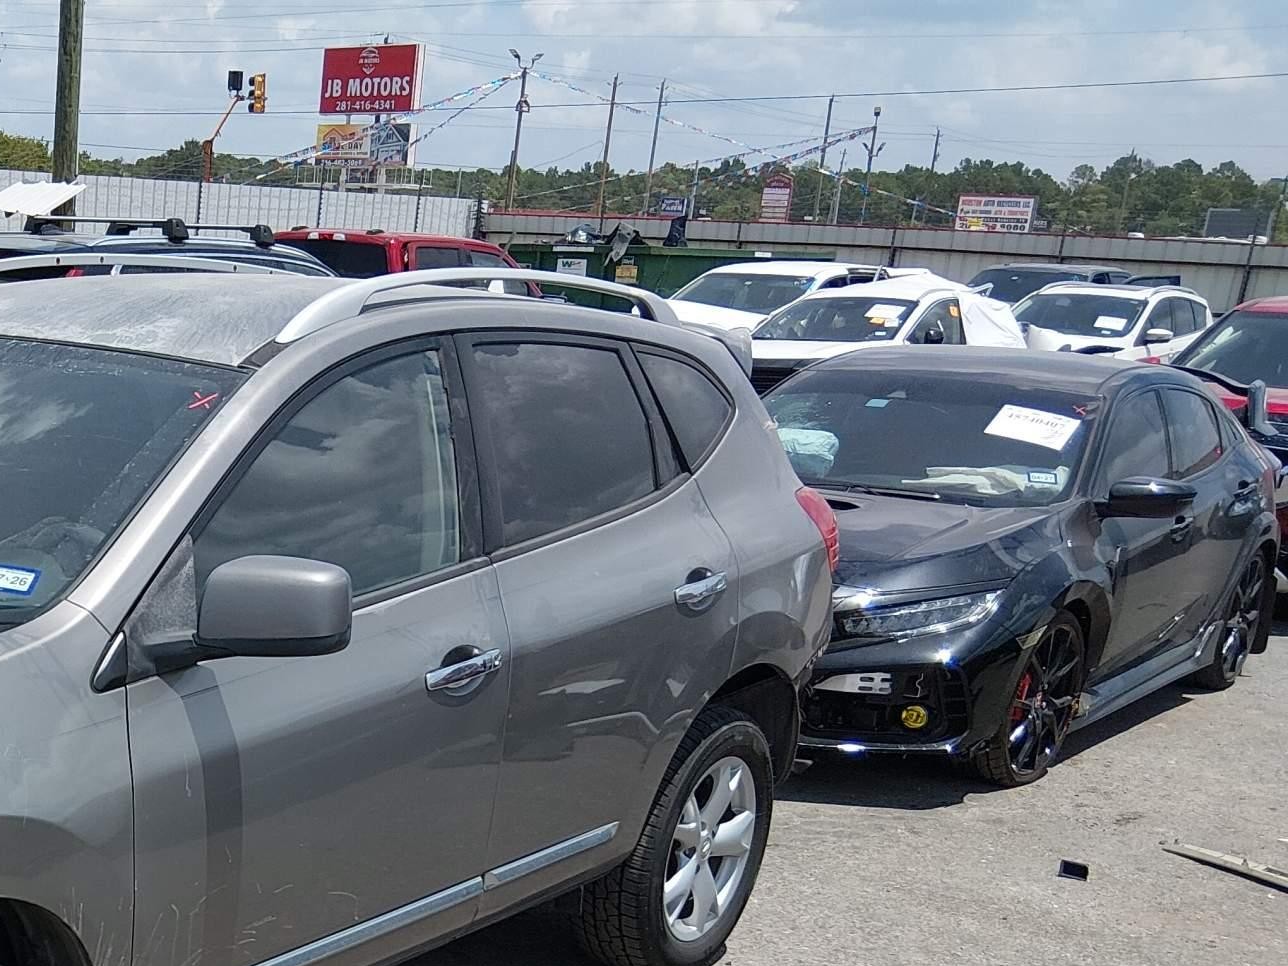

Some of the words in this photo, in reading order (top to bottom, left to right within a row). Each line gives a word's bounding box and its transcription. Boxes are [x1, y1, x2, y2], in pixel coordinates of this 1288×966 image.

[324, 79, 342, 98] JB
[346, 76, 411, 97] MOTORS
[335, 99, 395, 111] 281-416-4341
